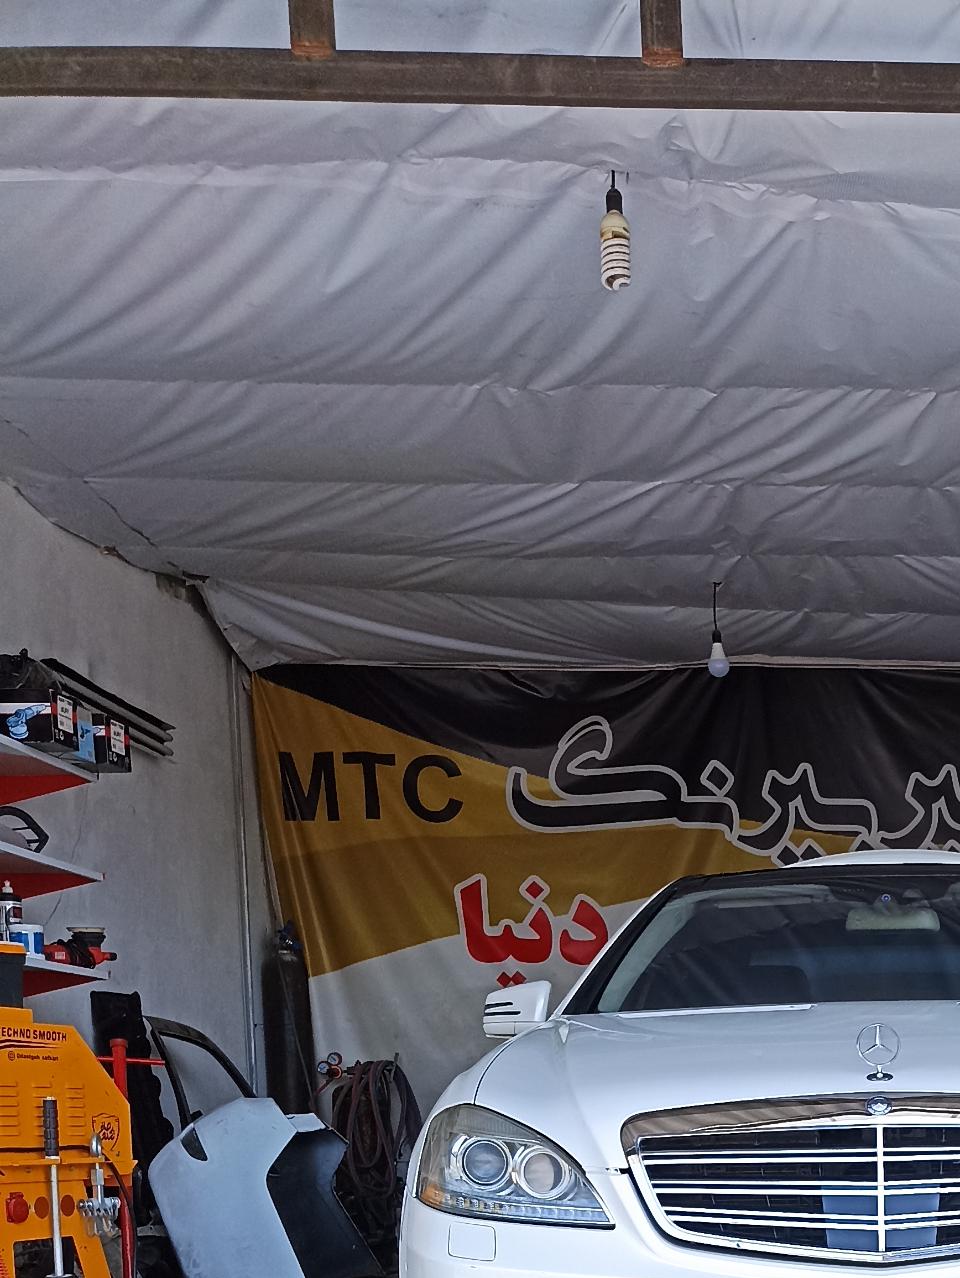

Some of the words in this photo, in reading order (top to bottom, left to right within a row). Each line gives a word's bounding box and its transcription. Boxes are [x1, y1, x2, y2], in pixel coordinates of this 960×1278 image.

[278, 750, 464, 824] MTC
[456, 875, 610, 989] دنیا
[0, 1026, 31, 1039] ECHNO
[32, 1029, 67, 1042] SMOOTH
